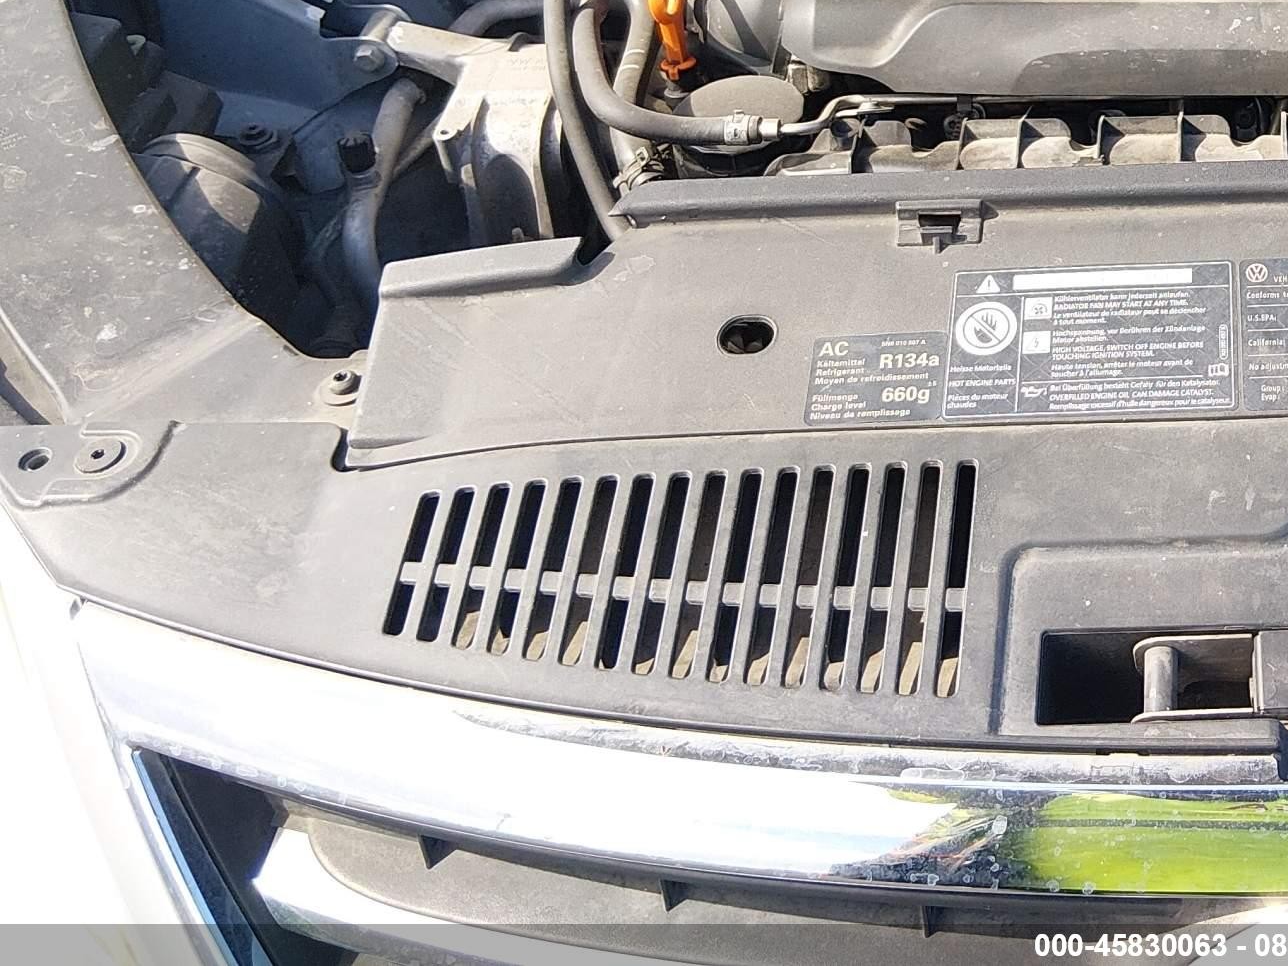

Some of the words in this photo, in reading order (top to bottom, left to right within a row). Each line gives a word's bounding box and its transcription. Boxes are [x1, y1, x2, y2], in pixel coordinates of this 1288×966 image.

[1128, 292, 1157, 301] jederzeit
[1122, 300, 1143, 308] START
[1165, 325, 1205, 333] Zündanlage
[1248, 338, 1285, 346] California:
[819, 341, 849, 356] AC
[817, 358, 865, 368] Kältemittel
[880, 353, 940, 369] R134a
[816, 368, 864, 377] Refrigerant
[815, 377, 844, 385] Moyen
[860, 373, 929, 382] refroidissement
[812, 394, 858, 402] Füllmenge
[882, 386, 930, 404] 660g
[1050, 393, 1090, 401] OVERFILLED
[811, 403, 842, 412] Charge
[846, 401, 866, 409] level
[1175, 399, 1190, 407] pour
[858, 409, 910, 418] remplissage
